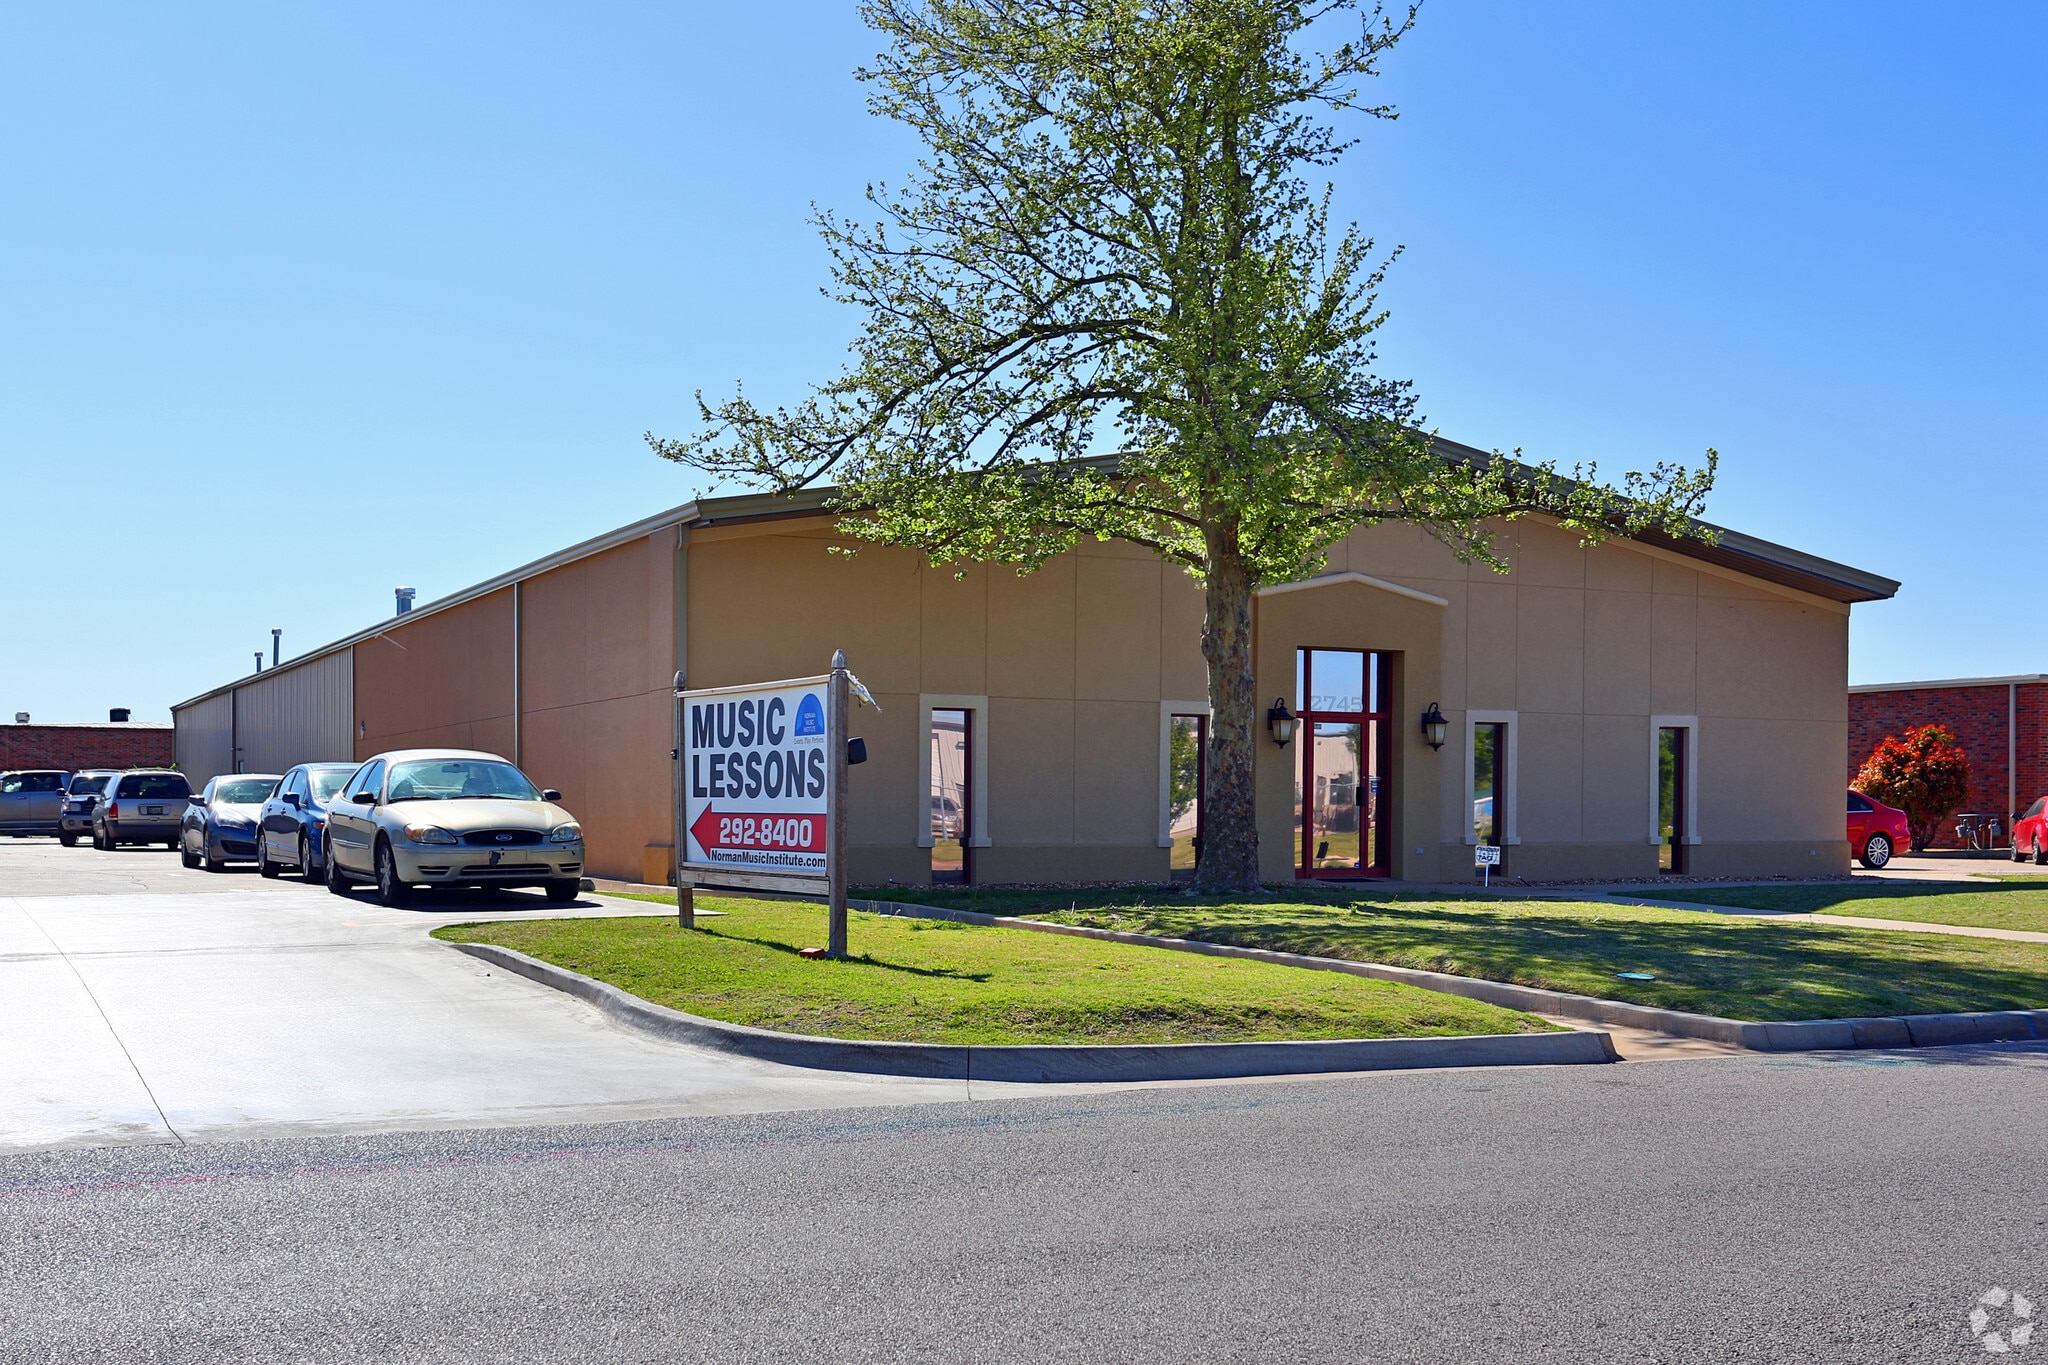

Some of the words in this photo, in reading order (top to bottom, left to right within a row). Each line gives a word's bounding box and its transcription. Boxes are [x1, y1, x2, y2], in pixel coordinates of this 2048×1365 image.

[1311, 695, 1363, 712] 2745
[692, 697, 785, 748] MUSIC
[692, 748, 825, 799] LESSONS
[719, 817, 813, 848] 292-8400
[711, 850, 826, 868] NormanMusicInstitute.com
